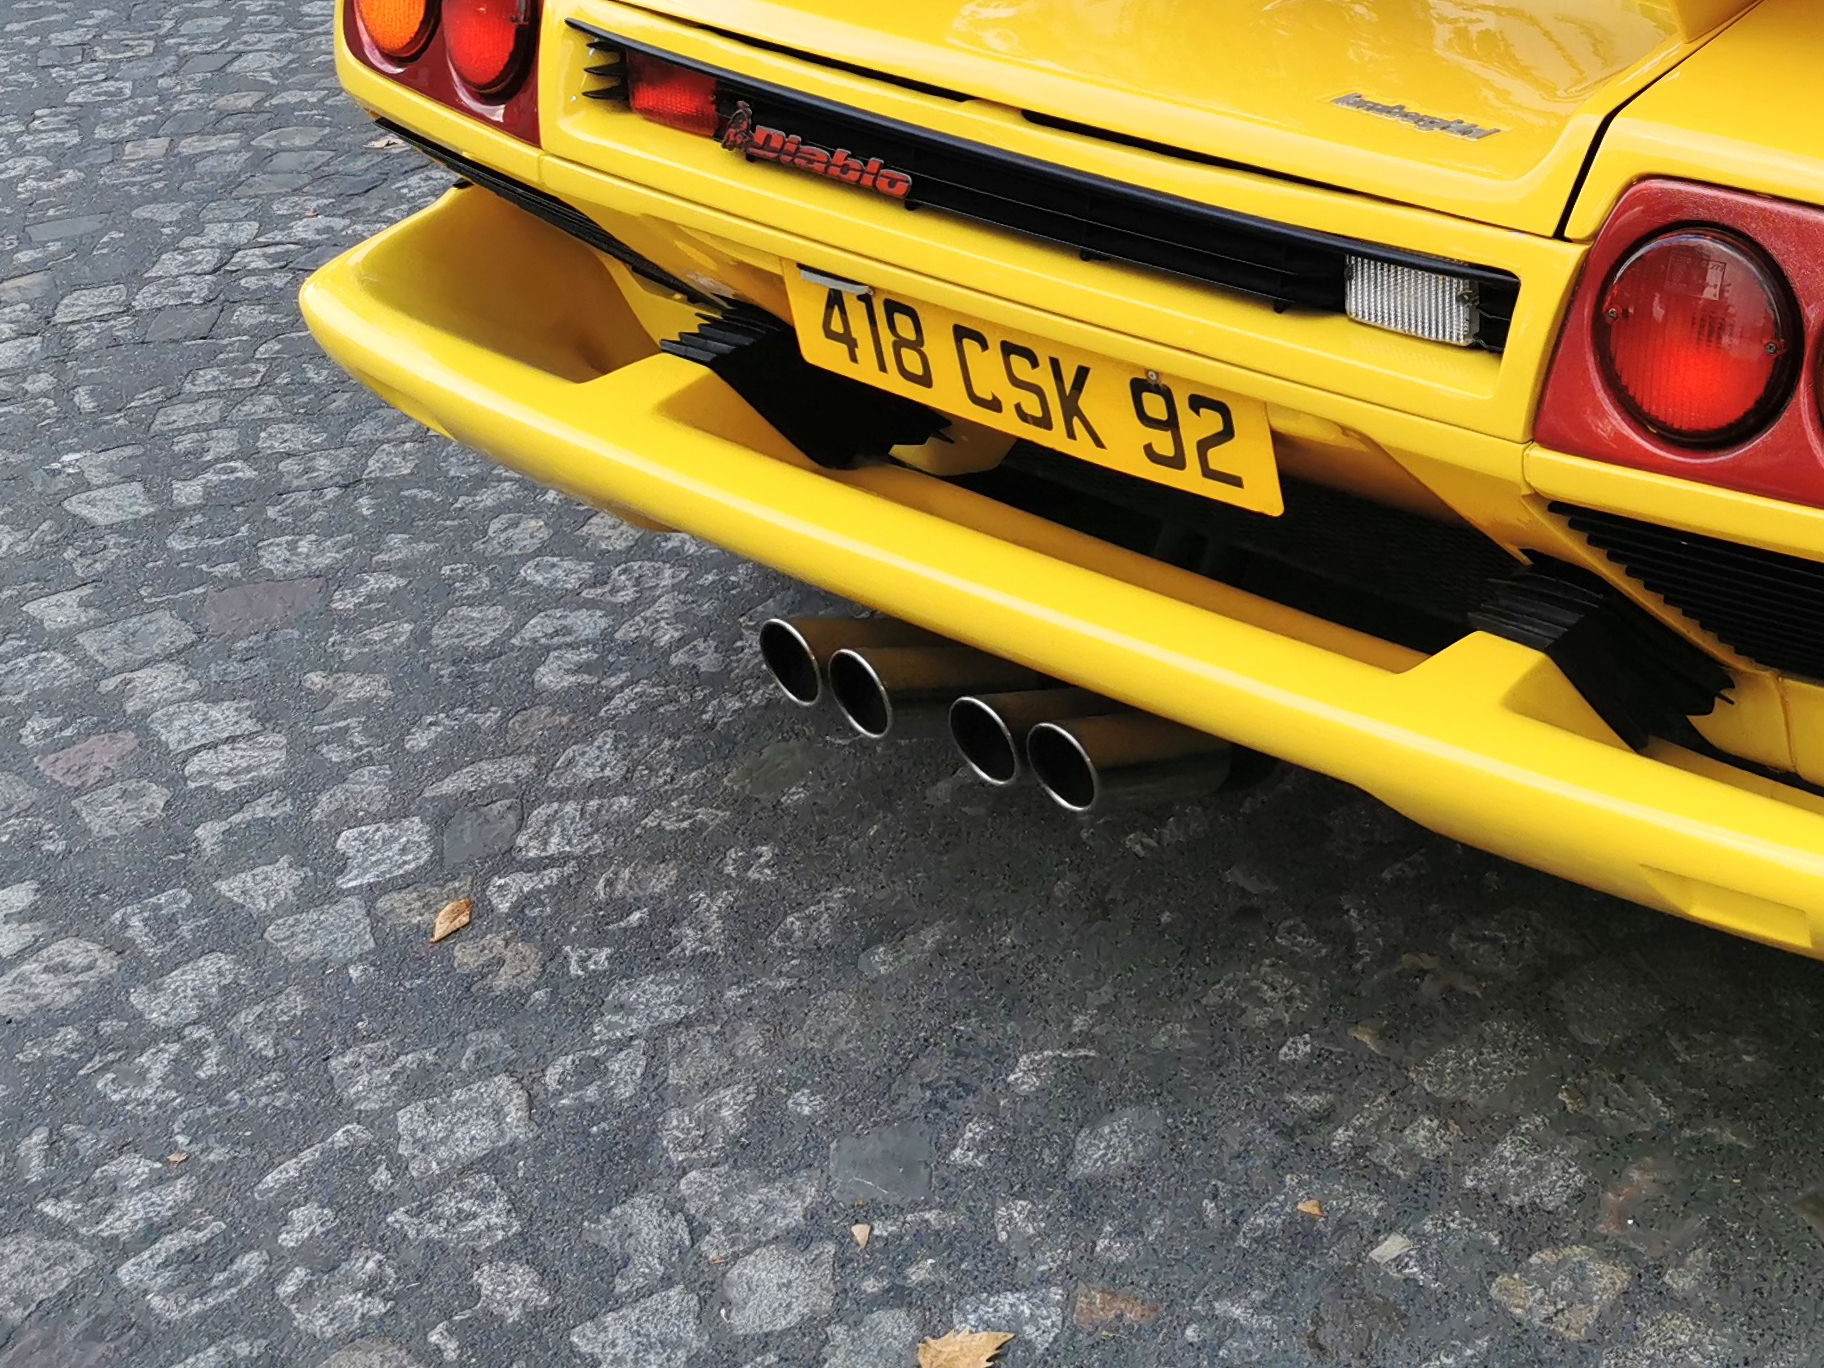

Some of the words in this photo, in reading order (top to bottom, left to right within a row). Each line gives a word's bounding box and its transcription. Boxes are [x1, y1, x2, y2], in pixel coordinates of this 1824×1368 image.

[746, 125, 913, 200] Diablo
[823, 287, 934, 389] 418
[952, 323, 1107, 451] CSK
[1129, 376, 1244, 489] 92
